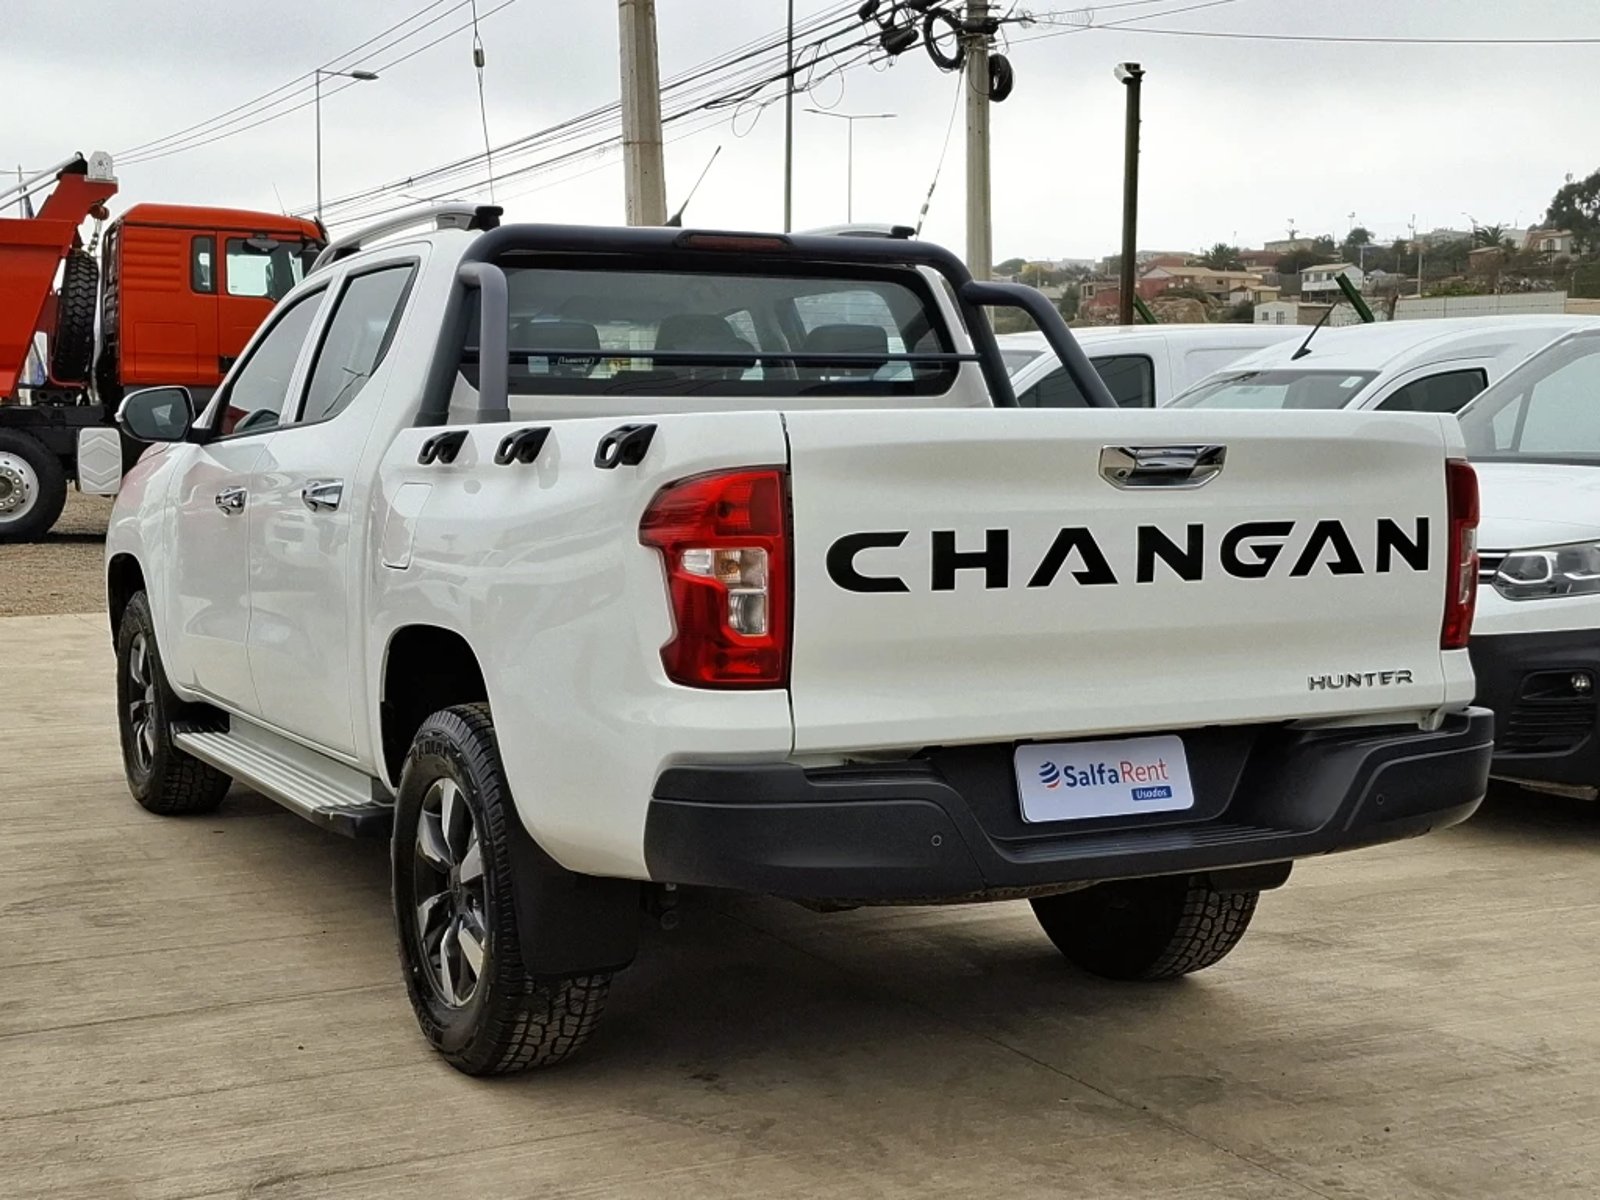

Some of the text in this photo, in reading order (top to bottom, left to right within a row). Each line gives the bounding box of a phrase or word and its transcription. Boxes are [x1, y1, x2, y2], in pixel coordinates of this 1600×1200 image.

[826, 517, 1429, 593] CHANGAN
[1308, 669, 1414, 691] HUNTER
[1063, 758, 1169, 788] SalfaRent
[1135, 786, 1168, 799] Usados
